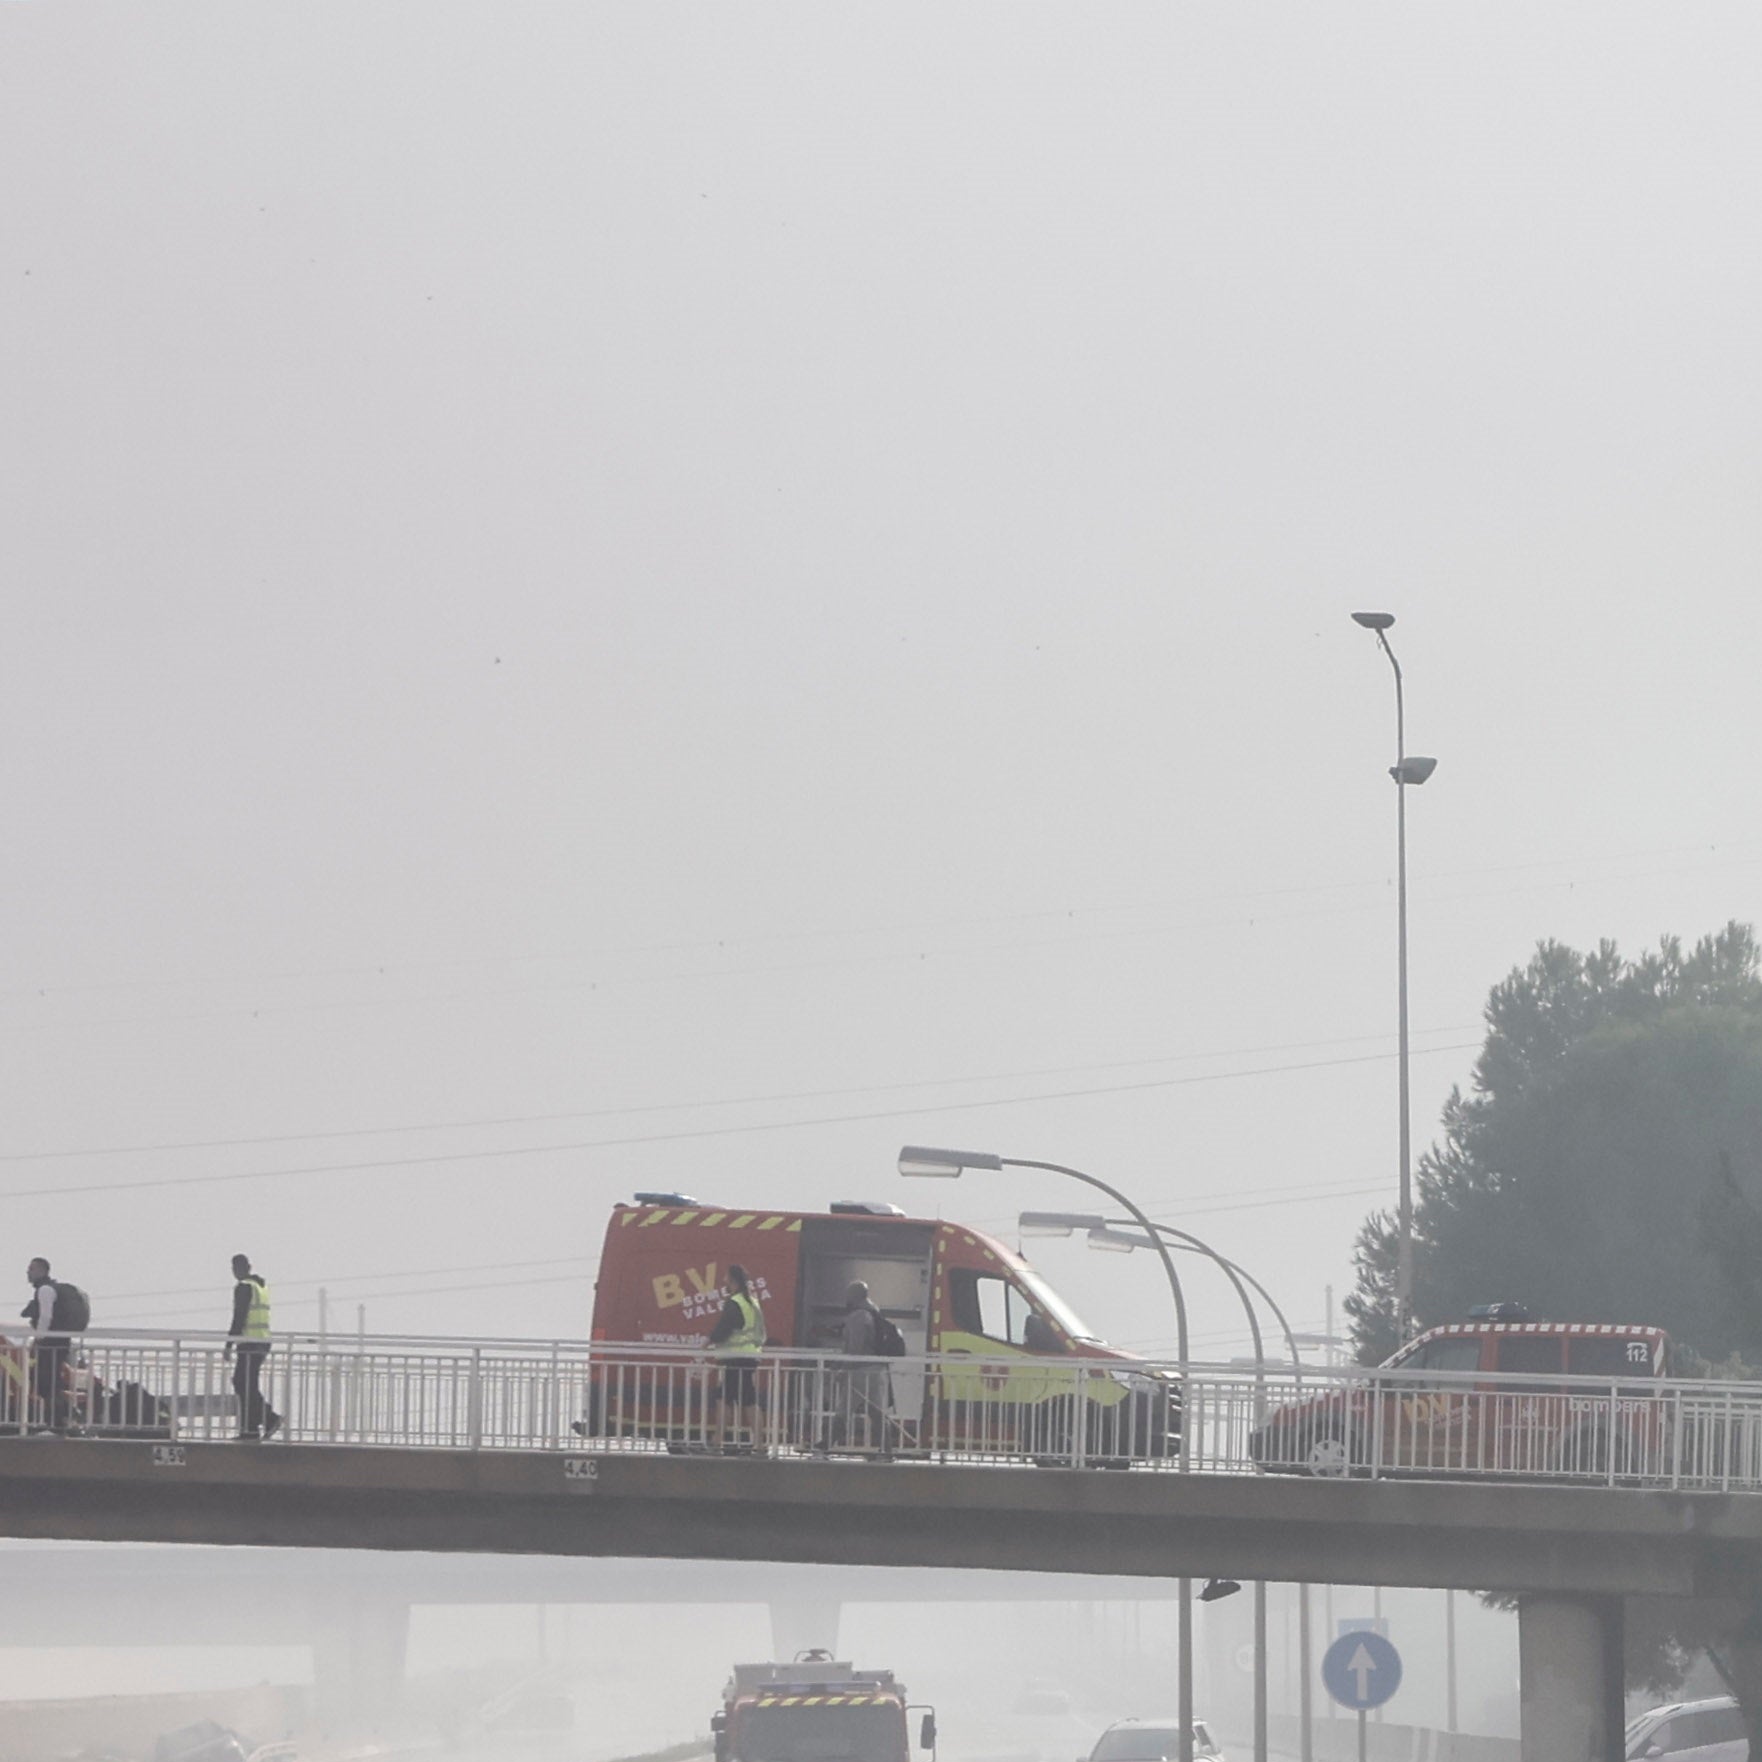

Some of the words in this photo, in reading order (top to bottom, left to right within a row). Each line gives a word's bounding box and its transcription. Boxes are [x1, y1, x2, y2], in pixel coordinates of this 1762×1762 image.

[652, 1263, 717, 1309] BV
[682, 1277, 767, 1307] BOMRS
[1626, 1349, 1648, 1362] 112
